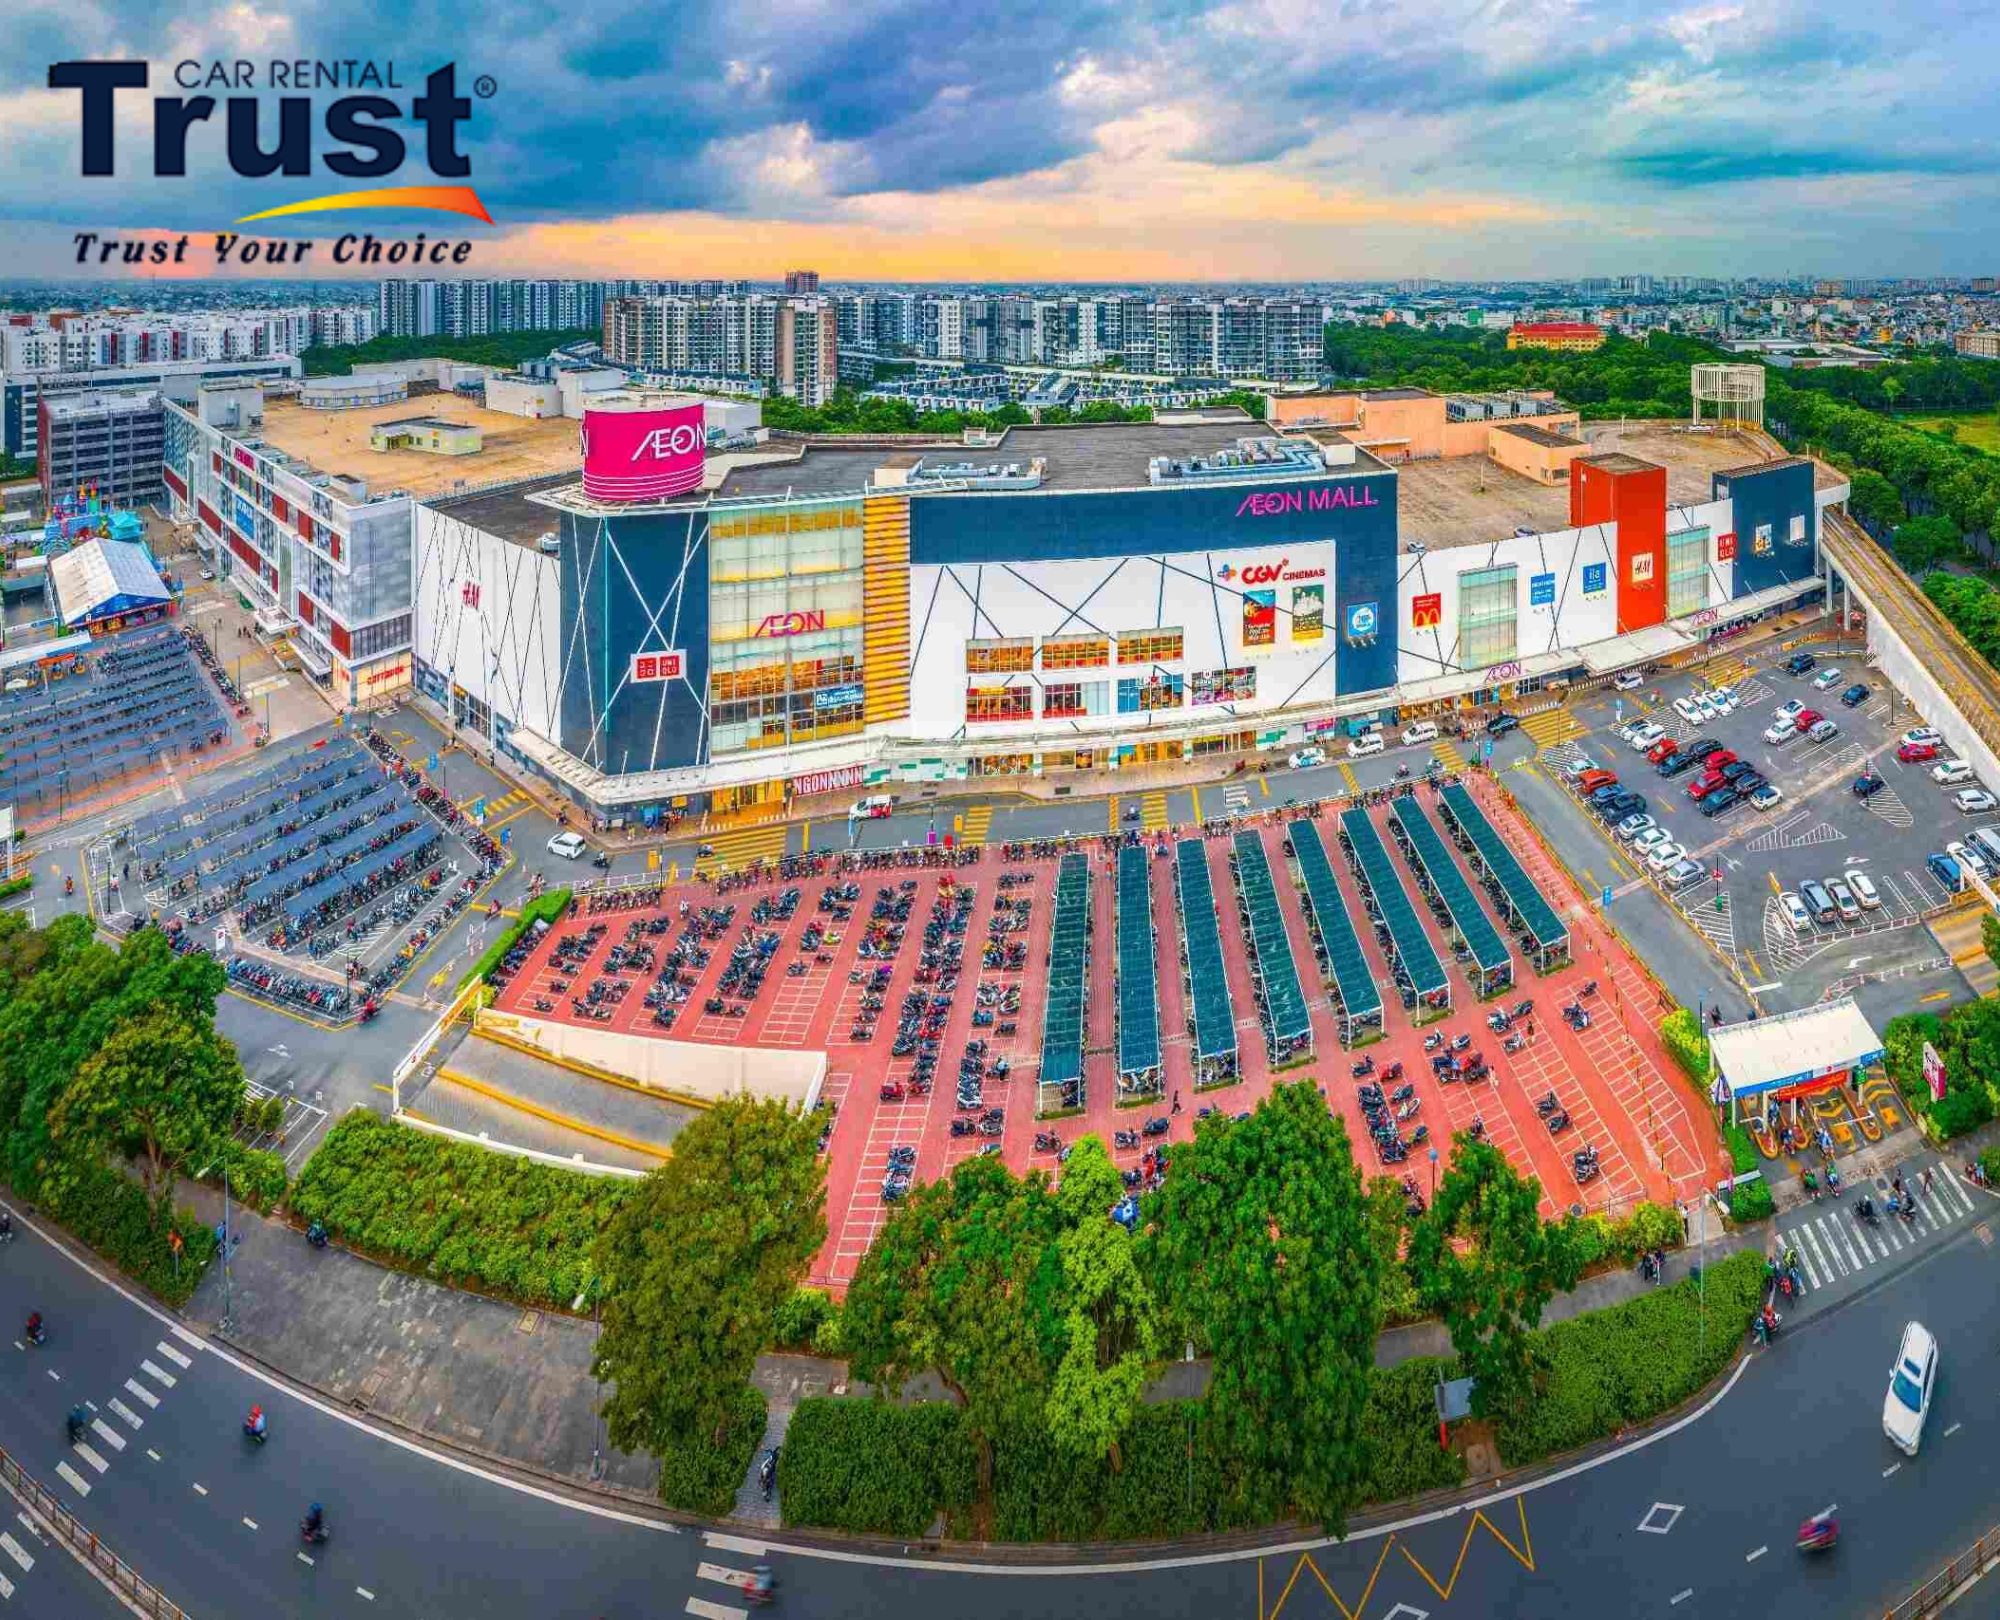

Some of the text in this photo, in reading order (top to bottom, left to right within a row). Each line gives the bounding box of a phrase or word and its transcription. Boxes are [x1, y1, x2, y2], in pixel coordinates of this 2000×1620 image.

[1309, 485, 1380, 510] MALL
[1241, 564, 1326, 585] CGV CINEMAS
